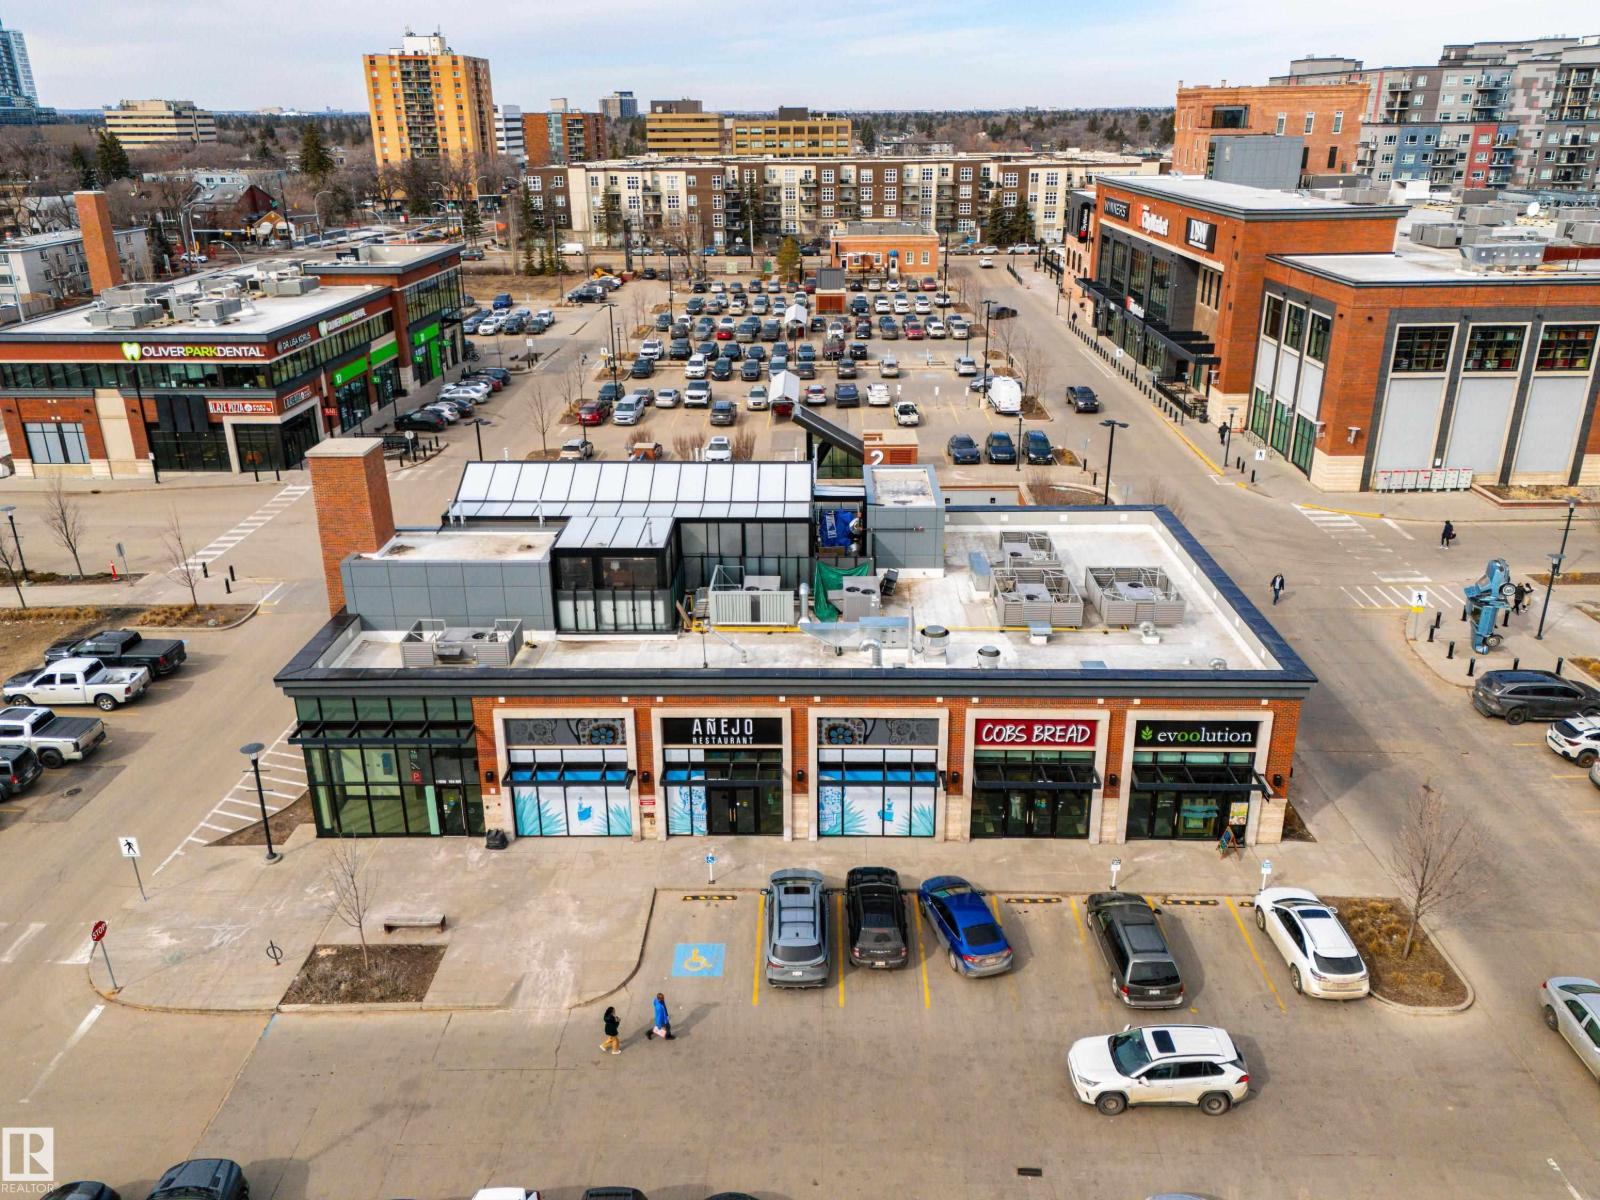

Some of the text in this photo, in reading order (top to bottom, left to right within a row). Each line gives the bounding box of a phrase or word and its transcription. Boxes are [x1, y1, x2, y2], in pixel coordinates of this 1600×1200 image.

[1104, 202, 1126, 218] WINNERS
[870, 449, 884, 465] 2
[692, 718, 754, 735] AÑEJO
[982, 723, 1091, 743] COBS BREAD
[1157, 726, 1253, 743] evoolution
[692, 736, 754, 745] RESTAURANT
[93, 923, 105, 939] STOP
